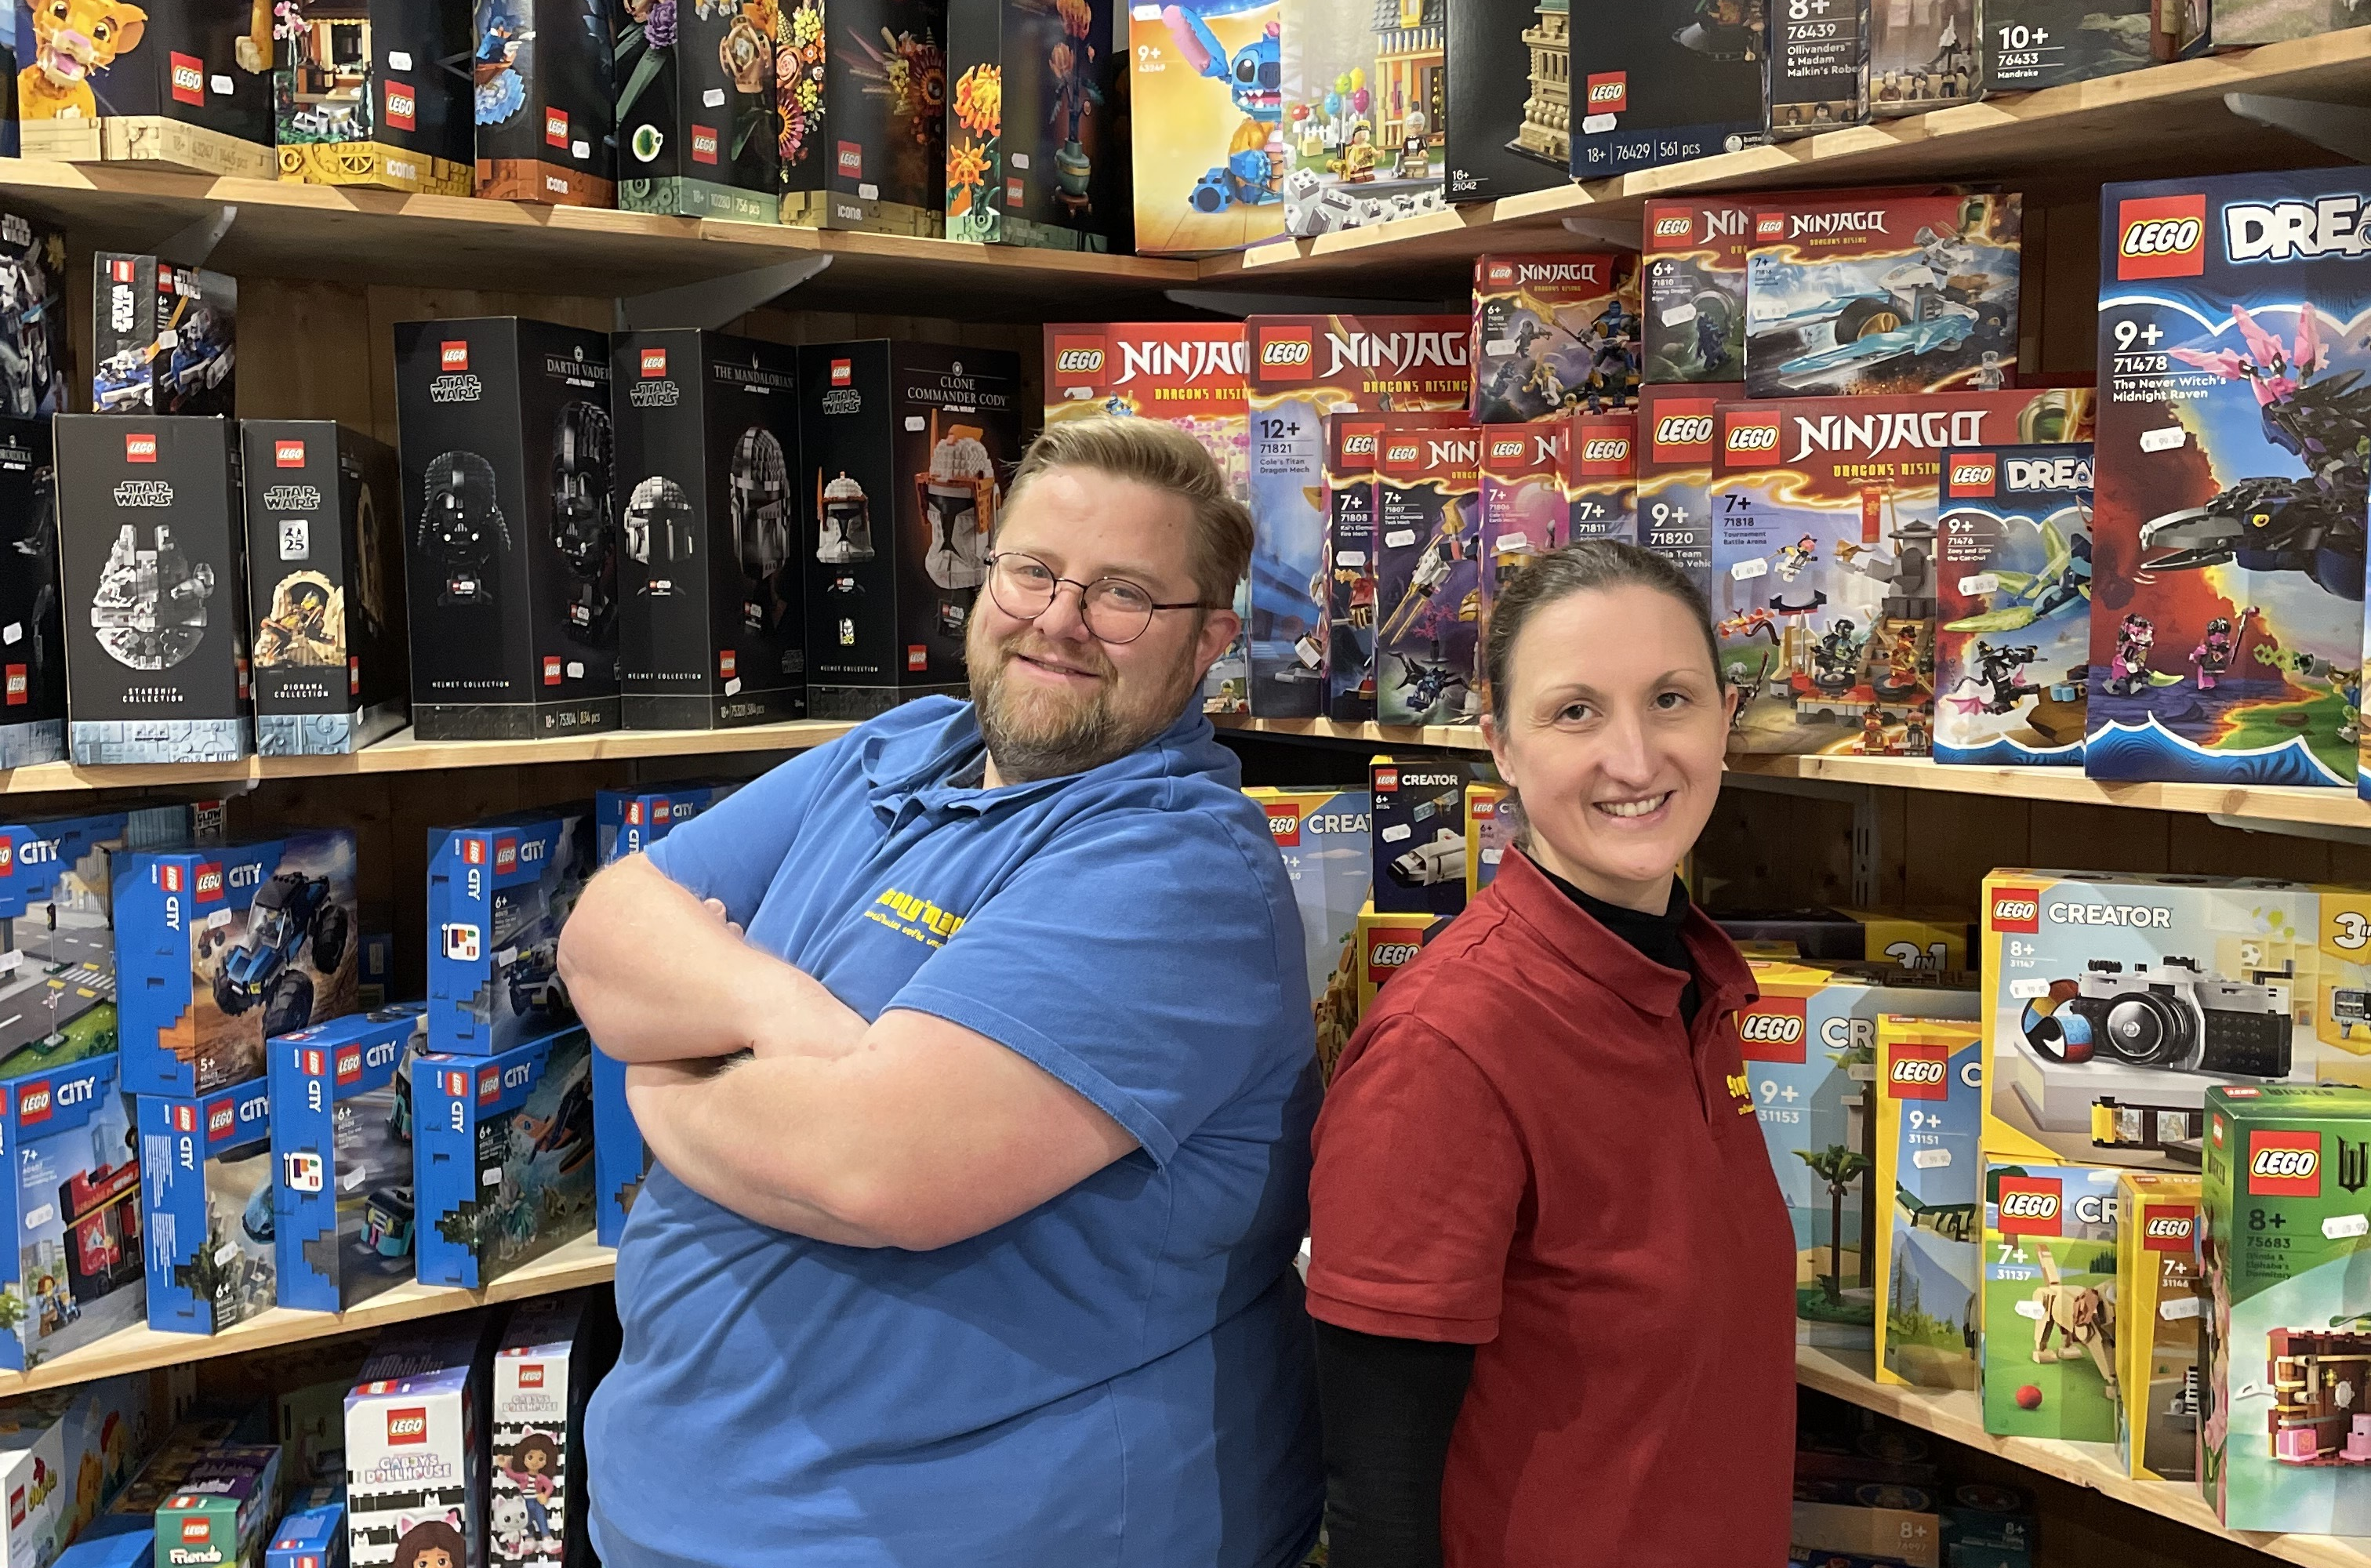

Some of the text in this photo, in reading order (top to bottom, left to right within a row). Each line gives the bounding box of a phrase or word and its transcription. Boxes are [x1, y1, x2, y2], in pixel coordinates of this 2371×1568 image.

[1789, 0, 1830, 19] 8+
[1787, 24, 1836, 39] 76439
[1999, 26, 2049, 50] 10+
[1137, 45, 1161, 61] 9+
[1787, 55, 1835, 67] & Madam
[1998, 53, 2039, 67] 76433
[1787, 67, 1828, 78] Malkin's
[1998, 69, 2039, 79] Mandrake
[174, 70, 202, 92] LEGO
[1589, 84, 1625, 103] LEGO
[387, 94, 413, 117] LEGO
[693, 136, 717, 153] LEGO
[1587, 142, 1701, 162] 18+ 76429 561 pcs
[840, 152, 860, 167] LEGO
[1452, 170, 1469, 181] 16+
[1452, 181, 1476, 192] 21042
[1654, 219, 1690, 235] LEGO
[1758, 220, 1782, 232] LEGO
[1788, 211, 1890, 240] NINJAGO
[2124, 220, 2201, 254] LEGO
[1516, 263, 1599, 285] NINJAGO
[1652, 263, 1675, 276] 6+
[1487, 306, 1501, 314] 6+
[2114, 321, 2163, 351] 9+
[1058, 350, 1102, 371] LEGO
[1264, 342, 1310, 365] LEGO
[1320, 332, 1467, 378] NINJAG
[546, 359, 579, 376] DARTH
[713, 365, 732, 379] THE
[2114, 356, 2168, 373] 71478
[430, 374, 481, 390] STAR
[630, 380, 679, 394] STAR
[940, 376, 975, 390] CLONE
[1363, 380, 1468, 394] DRAGONS RISING
[2113, 375, 2227, 390] The Never Witch's
[430, 388, 482, 403] WARS
[630, 392, 679, 407] WARS
[907, 387, 977, 405] COMMANDER
[1154, 389, 1210, 400] DRAGONS
[2113, 389, 2208, 403] Midnight Raven
[1259, 419, 1300, 438] 12+
[1658, 417, 1714, 442] LEGO
[1787, 410, 1989, 463] NINJAGO
[1728, 427, 1777, 448] LEGO
[129, 442, 155, 455] LEGO
[278, 448, 304, 460] LEGO
[1259, 444, 1292, 454] 71821
[1388, 446, 1418, 460] LEGO
[1492, 442, 1523, 456] LEGO
[1584, 440, 1628, 461] LEGO
[1259, 466, 1287, 475] Dragon
[1833, 463, 1895, 477] DRAGONS
[1952, 467, 1992, 484] LEGO
[114, 481, 172, 493] STAR
[263, 485, 321, 498] STAR
[1489, 488, 1506, 502] 7+
[114, 492, 173, 507] WARS
[264, 496, 321, 510] WARS
[1340, 495, 1363, 510] 7+
[1385, 492, 1401, 503] 7+
[1725, 495, 1752, 514] 7+
[1580, 502, 1606, 521] 7+
[1650, 503, 1689, 528] 9+
[1580, 524, 1606, 533] 71811
[1724, 517, 1755, 528] 71818
[1948, 518, 1973, 534] 9+
[284, 539, 305, 551] 25
[1650, 532, 1694, 545] 71820
[1948, 537, 1974, 546] 71476
[1676, 550, 1702, 558] Team
[1402, 774, 1459, 786] CREATOR
[1375, 794, 1389, 804] 6+
[673, 803, 694, 818] CITY
[19, 837, 61, 865] CITY
[521, 838, 546, 862] CITY
[198, 873, 223, 891] LEGO
[228, 862, 263, 888] CITY
[468, 868, 481, 901] CITY
[495, 895, 507, 909] 6+
[1994, 899, 2035, 919] LEGO
[166, 896, 180, 931] CITY
[2048, 902, 2171, 929] CREATOR
[1373, 944, 1421, 966] LEGO
[2010, 941, 2035, 956] 8+
[1741, 1017, 1802, 1042] LEGO
[1820, 1017, 1875, 1049] CR
[365, 1040, 397, 1068] CITY
[200, 1058, 216, 1072] 5+
[338, 1054, 361, 1075] LEGO
[1893, 1062, 1944, 1083] LEGO
[504, 1062, 532, 1088] CITY
[57, 1076, 96, 1106] CITY
[309, 1080, 321, 1113] CITY
[1759, 1080, 1799, 1105] 9+
[23, 1092, 50, 1113] LEGO
[209, 1110, 234, 1131] LEGO
[337, 1107, 352, 1121] 6+
[452, 1101, 464, 1134] CITY
[1759, 1109, 1799, 1123] 31153
[1908, 1110, 1941, 1131] 9+
[479, 1124, 492, 1140] 6+
[1908, 1134, 1939, 1145] 31151
[22, 1149, 38, 1165] 7+
[180, 1137, 194, 1171] CITY
[2253, 1149, 2318, 1177] LEGO
[2002, 1194, 2057, 1217] LEGO
[2148, 1218, 2191, 1237] LEGO
[2249, 1208, 2286, 1231] 8+
[2246, 1236, 2291, 1250] 75683
[1997, 1244, 2029, 1265] 7+
[1997, 1269, 2032, 1282] 31137
[2162, 1259, 2187, 1276] 7+
[216, 1283, 230, 1298] 6+
[502, 1401, 558, 1412] DOLLHOUSE
[390, 1418, 423, 1434] LEGO
[379, 1453, 439, 1470] GABBY'S
[365, 1463, 452, 1484] DOLLHOUSE
[1900, 1522, 1927, 1539] 8+
[169, 1544, 223, 1565] Friends
